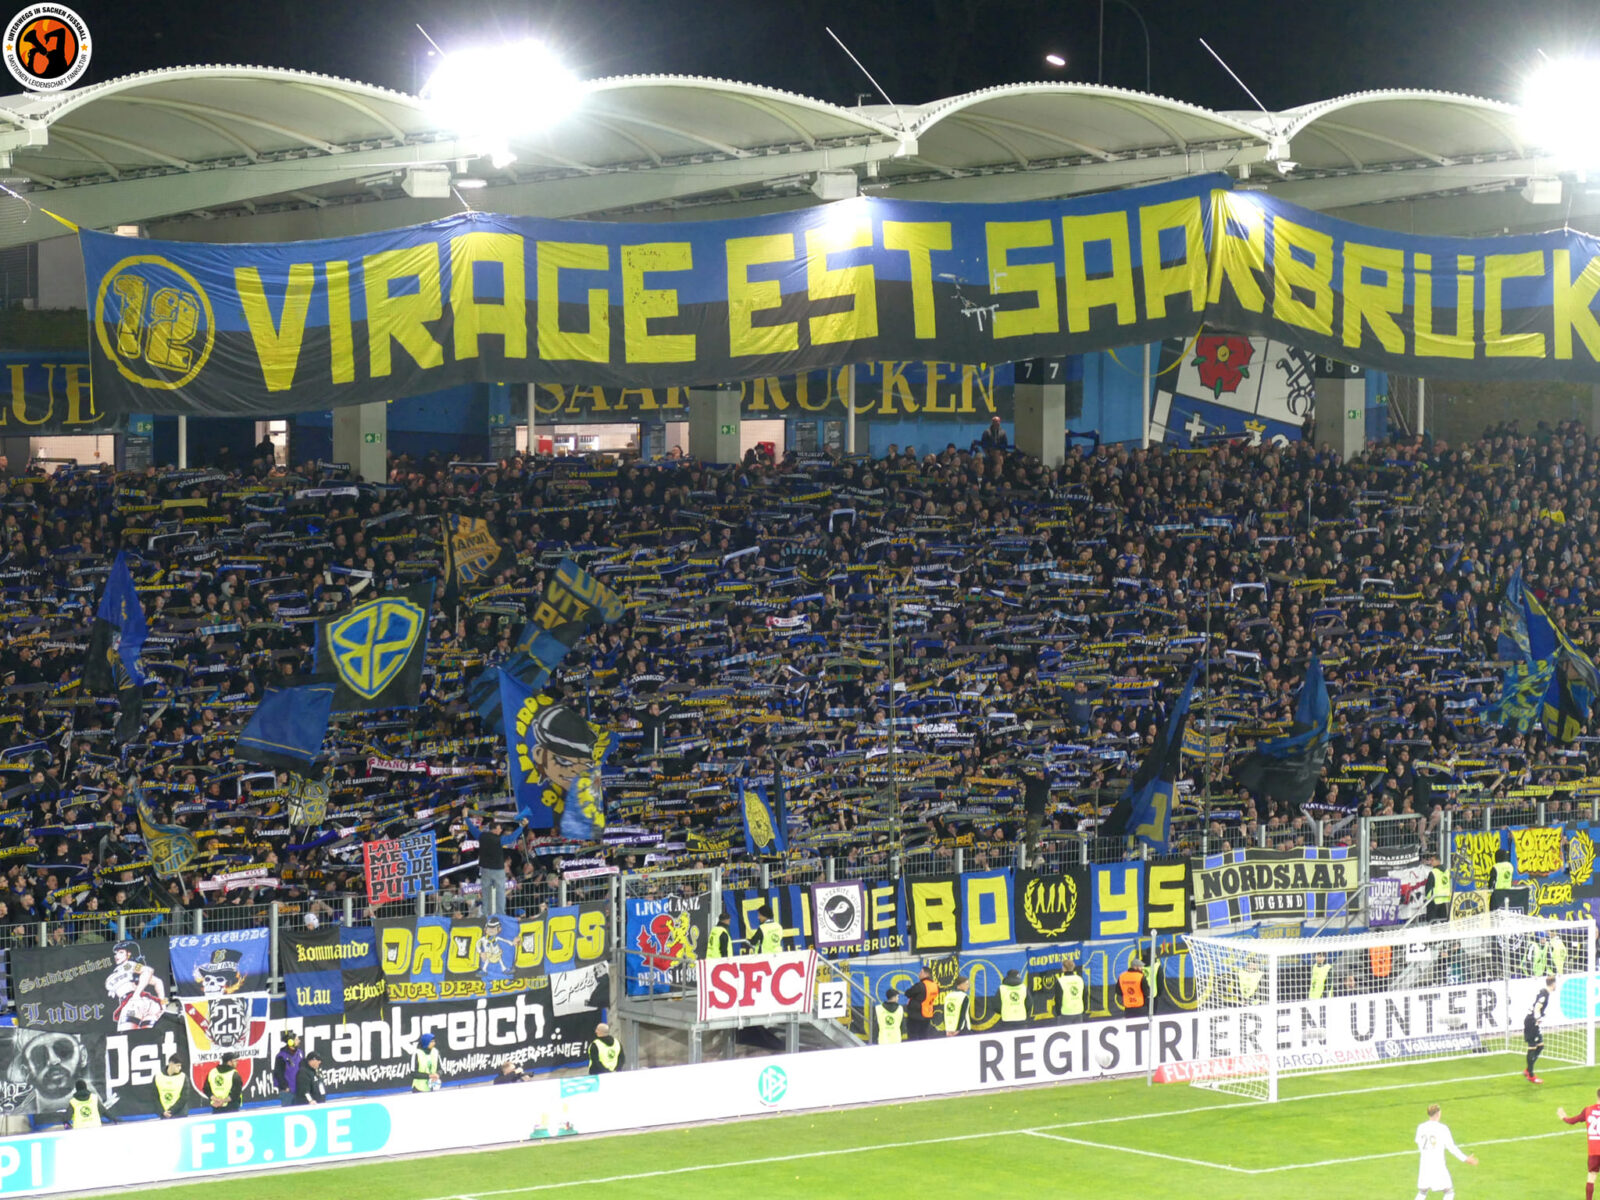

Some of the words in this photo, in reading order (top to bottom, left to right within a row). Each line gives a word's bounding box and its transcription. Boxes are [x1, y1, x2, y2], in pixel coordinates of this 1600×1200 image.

[234, 232, 696, 392] VIRAGE
[725, 219, 952, 358] EST
[1050, 362, 1059, 379] 7
[368, 835, 432, 853] LAUTERN
[370, 845, 432, 865] METZ
[370, 862, 407, 881] FILS
[412, 857, 432, 872] DE
[371, 872, 434, 901] PUTE
[1201, 864, 1347, 900] NORDSAAR
[1370, 881, 1399, 897] TOUGH
[1254, 894, 1303, 910] JUGEND
[1369, 905, 1396, 921] GUYS
[19, 956, 113, 994] Stadtgraben
[638, 968, 673, 987] DEPUIS
[709, 961, 805, 1010] SFC
[344, 977, 387, 1002] schwar
[388, 979, 436, 1000] NUR
[440, 977, 486, 997] DER
[822, 990, 844, 1010] E2
[20, 1001, 105, 1027] Luder
[213, 1005, 242, 1035] 25
[980, 1006, 1327, 1083] REGISTRIEREN
[1404, 1034, 1474, 1052] Volkswagen
[192, 1108, 353, 1169] FB.DE
